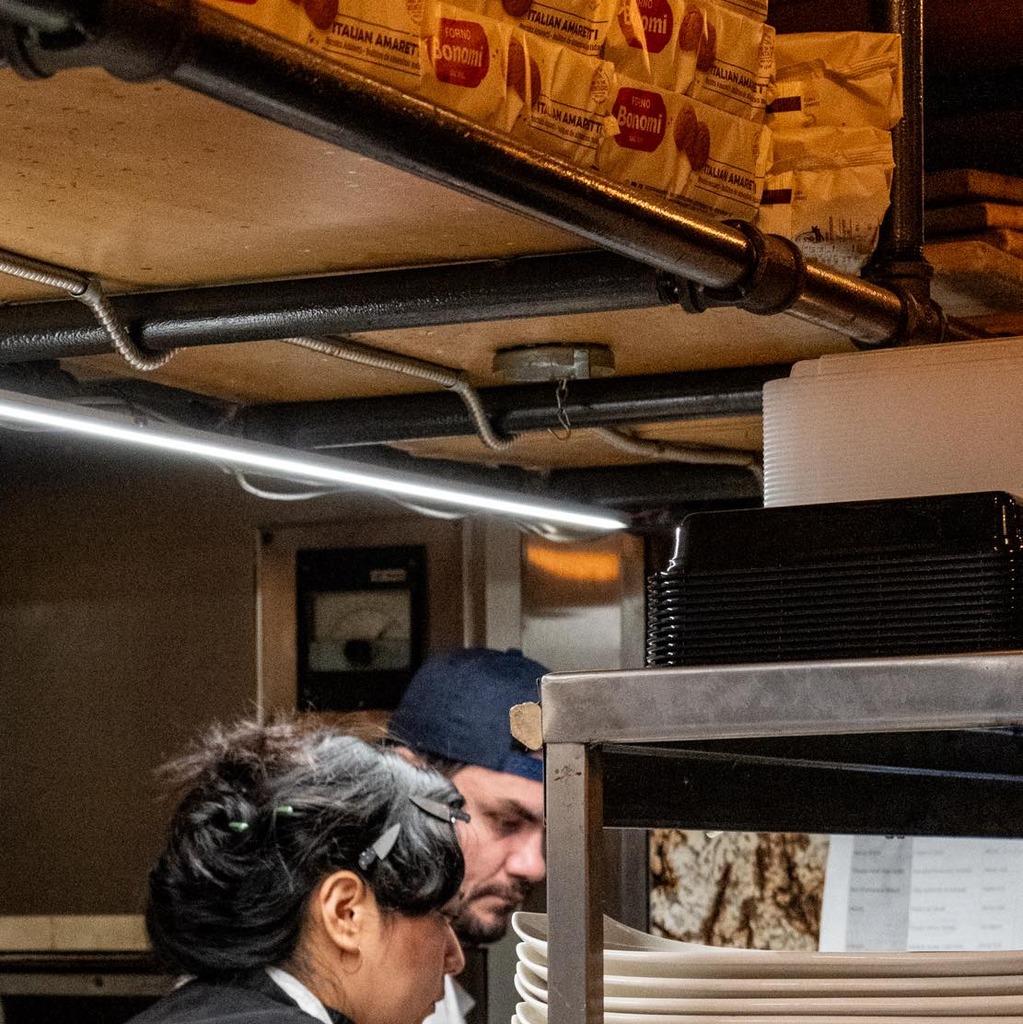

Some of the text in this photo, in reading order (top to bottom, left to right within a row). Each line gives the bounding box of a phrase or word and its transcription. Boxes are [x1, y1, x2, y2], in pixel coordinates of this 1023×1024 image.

[527, 9, 562, 30] ITALIAN
[332, 21, 374, 44] ITALIAN
[445, 27, 472, 40] FORNO
[434, 41, 484, 68] Bonomi
[617, 104, 662, 134] Bonomi
